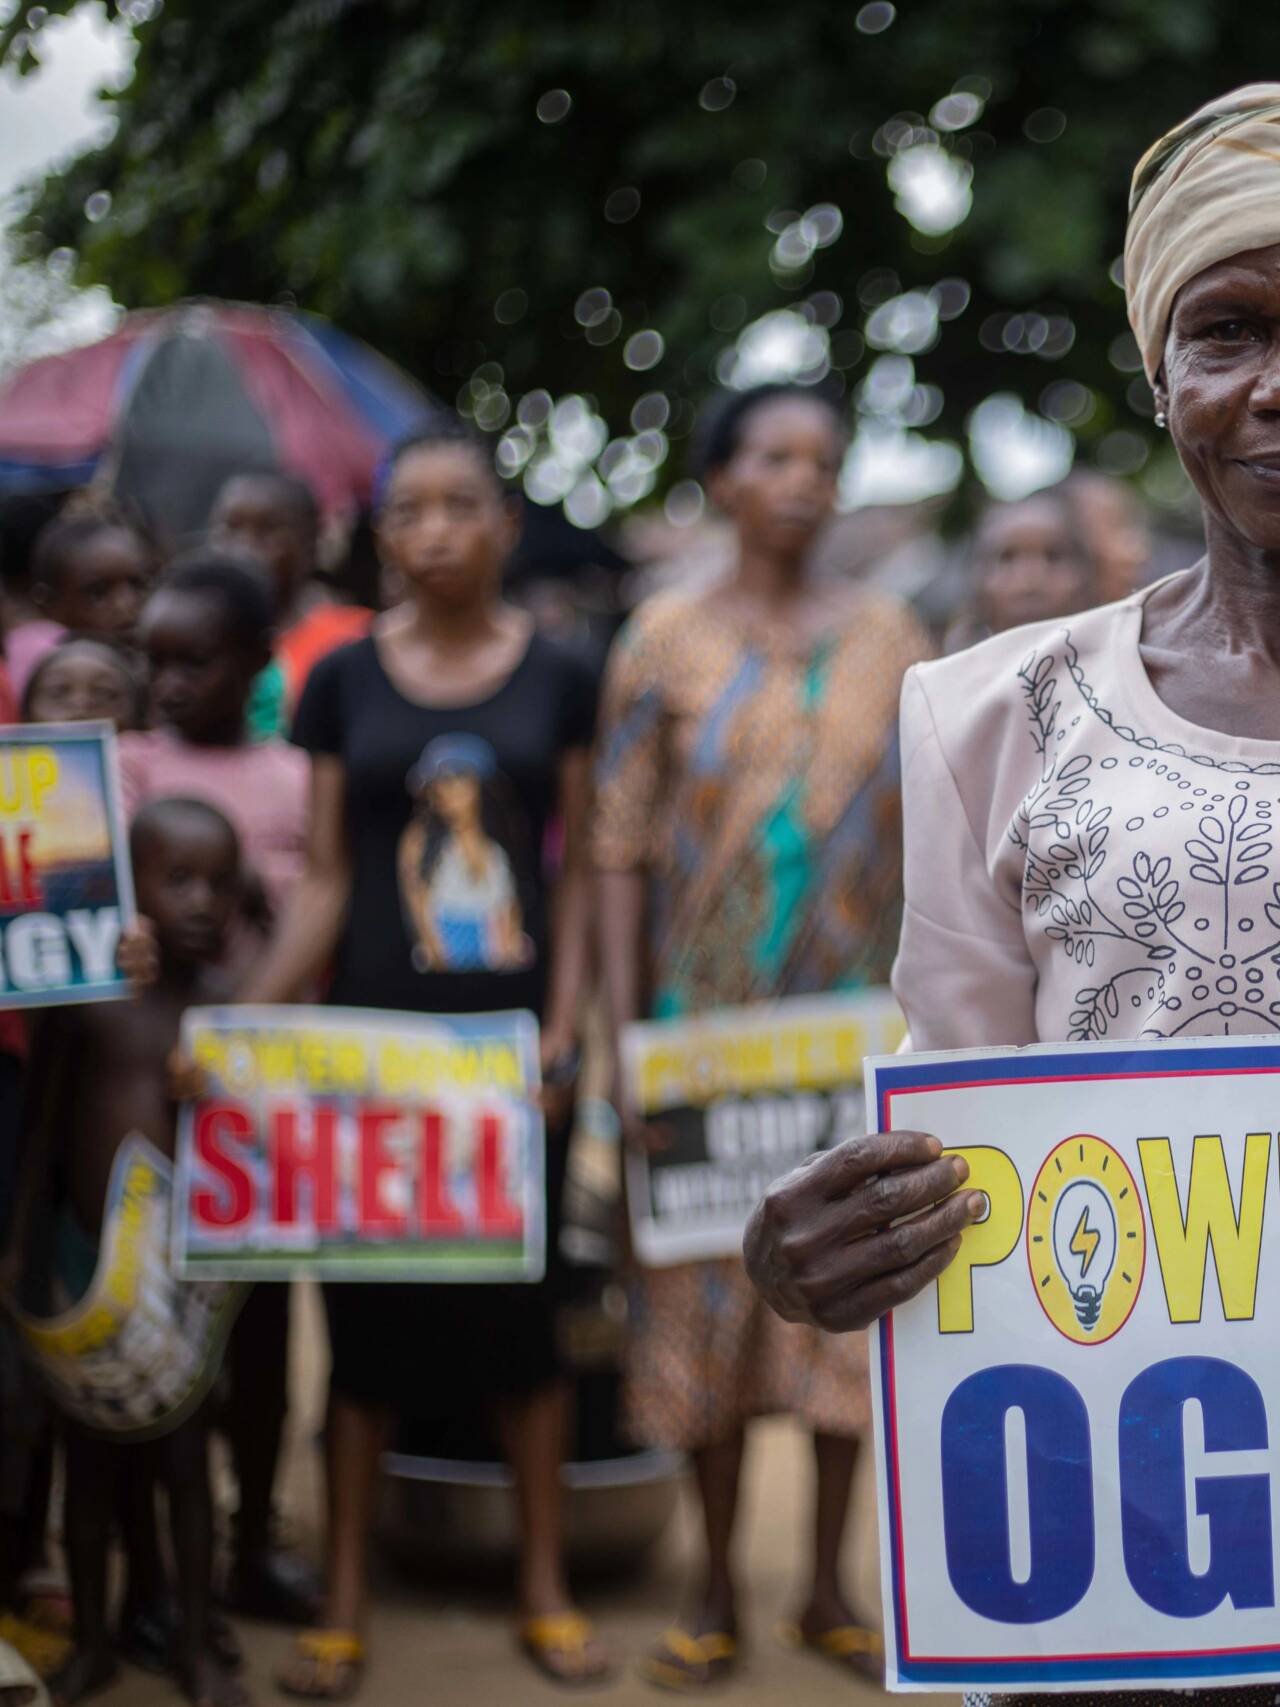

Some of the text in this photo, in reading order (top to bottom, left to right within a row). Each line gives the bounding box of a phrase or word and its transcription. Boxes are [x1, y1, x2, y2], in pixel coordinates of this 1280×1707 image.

[0, 906, 120, 990] GY
[194, 1030, 364, 1097] POWER
[191, 1106, 524, 1238] SHELL
